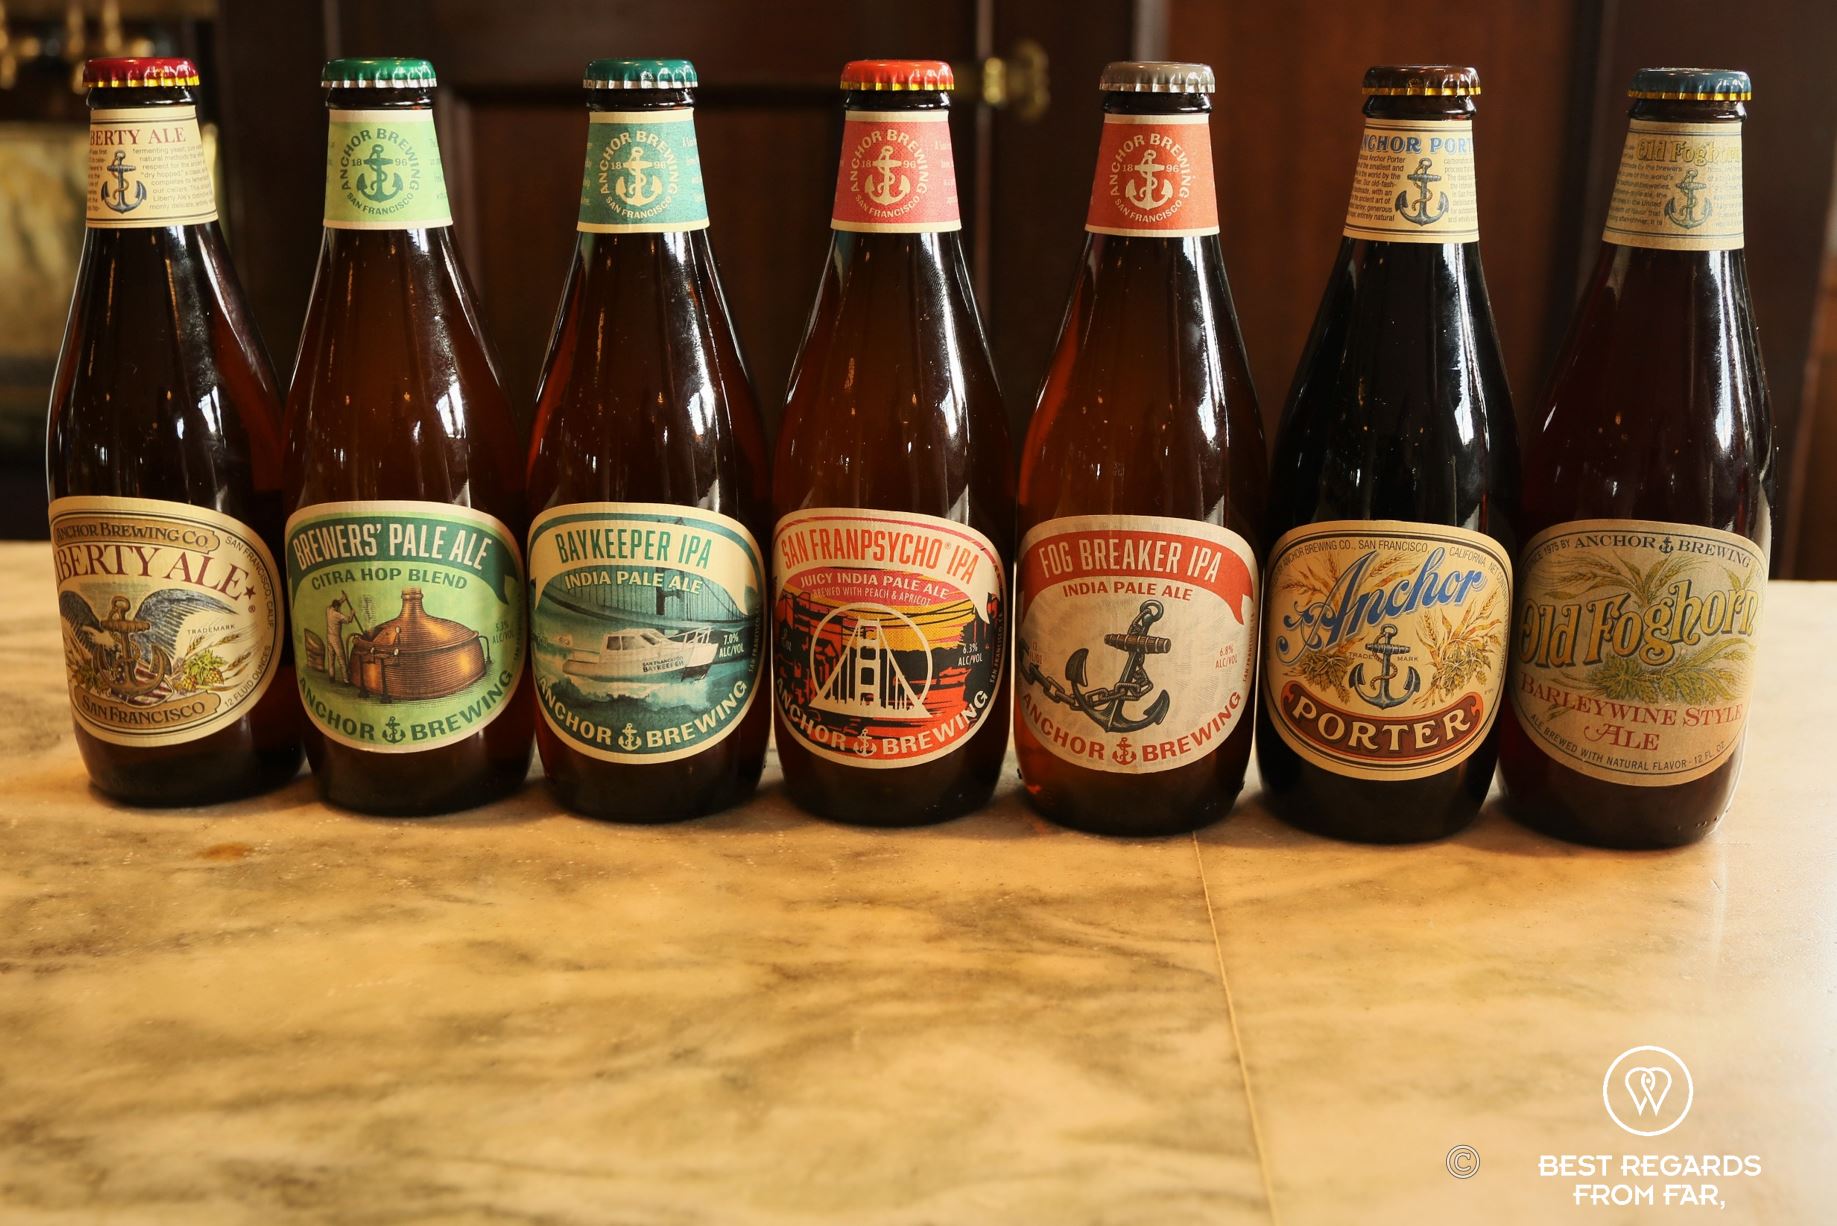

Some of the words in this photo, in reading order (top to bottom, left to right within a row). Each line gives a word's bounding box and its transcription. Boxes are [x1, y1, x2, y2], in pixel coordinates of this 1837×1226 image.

[90, 129, 140, 146] BERTY
[148, 127, 186, 145] ALE
[1361, 134, 1421, 154] NCHOR
[1429, 137, 1473, 154] PORT
[340, 129, 372, 190] ANCHOR
[376, 128, 420, 191] BREWING
[598, 132, 632, 194] ANCHOR
[636, 130, 678, 194] BREWING
[850, 130, 882, 192] ANCHOR
[887, 129, 928, 194] BREWING
[1387, 155, 1405, 164] Porter
[1636, 140, 1667, 162] Old
[1109, 135, 1145, 197] ANCHOR
[1149, 133, 1191, 199] BREWING
[1392, 164, 1404, 172] and
[347, 192, 362, 209] SAN
[362, 192, 413, 215] FRANCISCO
[606, 197, 620, 213] SAN
[621, 196, 672, 219] FRANCISCO
[856, 194, 869, 212] SAN
[869, 196, 920, 218] FRANCISCO
[1115, 199, 1130, 215] SAN
[1130, 200, 1182, 223] FRANCISCO
[101, 522, 179, 541] BREWING
[225, 536, 244, 551] SAN
[389, 523, 447, 559] PALE
[449, 530, 493, 571] ALE
[555, 528, 671, 564] BAYKEEPER
[678, 534, 713, 569] IPA
[781, 534, 810, 570] SAN
[946, 544, 981, 584] IPA
[1039, 541, 1074, 579] FOG
[1078, 538, 1182, 574] BREAKER
[1186, 545, 1223, 583] IPA
[1305, 540, 1337, 555] BREWING
[1358, 539, 1376, 551] SAN
[1378, 540, 1430, 555] FRANCISCO,
[1449, 546, 1487, 567] CALIFORNIA
[1560, 538, 1570, 549] BY
[1574, 534, 1657, 549] ANCHOR
[1679, 539, 1751, 568] BREWING
[163, 551, 249, 602] ALE
[311, 569, 356, 591] CITRA
[361, 567, 402, 582] HOP
[408, 568, 468, 590] BLEND
[564, 570, 612, 590] INDIA
[616, 571, 664, 588] PALE
[668, 575, 703, 595] ALE
[800, 573, 833, 588] JUICY
[837, 573, 878, 586] INDIA
[882, 575, 920, 591] PALE
[923, 583, 950, 600] ALE
[812, 587, 840, 598] BREWED
[842, 586, 862, 597] WITH
[864, 587, 889, 599] PEACH
[891, 592, 897, 600] &
[898, 592, 932, 606] APRICOT
[1063, 581, 1108, 598] INDIA
[1113, 581, 1157, 596] PALE
[1163, 585, 1193, 602] ALE
[1276, 546, 1488, 667] Anchor
[186, 623, 236, 636] TRADEMARK
[1520, 598, 1582, 669] Old
[1584, 579, 1760, 667] Foghorn
[719, 643, 745, 658] ALC/VOL
[958, 653, 983, 666] ALC/VOL
[1215, 654, 1237, 669] ALC/VOL
[224, 698, 234, 708] 12
[233, 680, 254, 700] FLUID
[299, 677, 375, 741] ANCHOR
[410, 670, 513, 741] BREWING
[1521, 672, 1677, 726] BARLEYWINE
[1682, 703, 1744, 728] STYLE
[81, 694, 107, 719] SAN
[109, 701, 205, 725] FRANCISCO
[538, 677, 612, 745] ANCHOR
[646, 680, 748, 748] BREWING
[775, 678, 847, 751] ANCHOR
[882, 690, 988, 755] BREWING
[1291, 695, 1471, 751] PORTER
[1023, 693, 1105, 761] ANCHOR
[1142, 691, 1242, 762] BREWING
[1583, 724, 1661, 751] ALE
[1531, 714, 1543, 730] ALE
[1544, 728, 1579, 753] BREWED
[1580, 748, 1604, 763] WITH
[1606, 756, 1649, 771] NATURAL
[1653, 760, 1688, 771] FLAVOR
